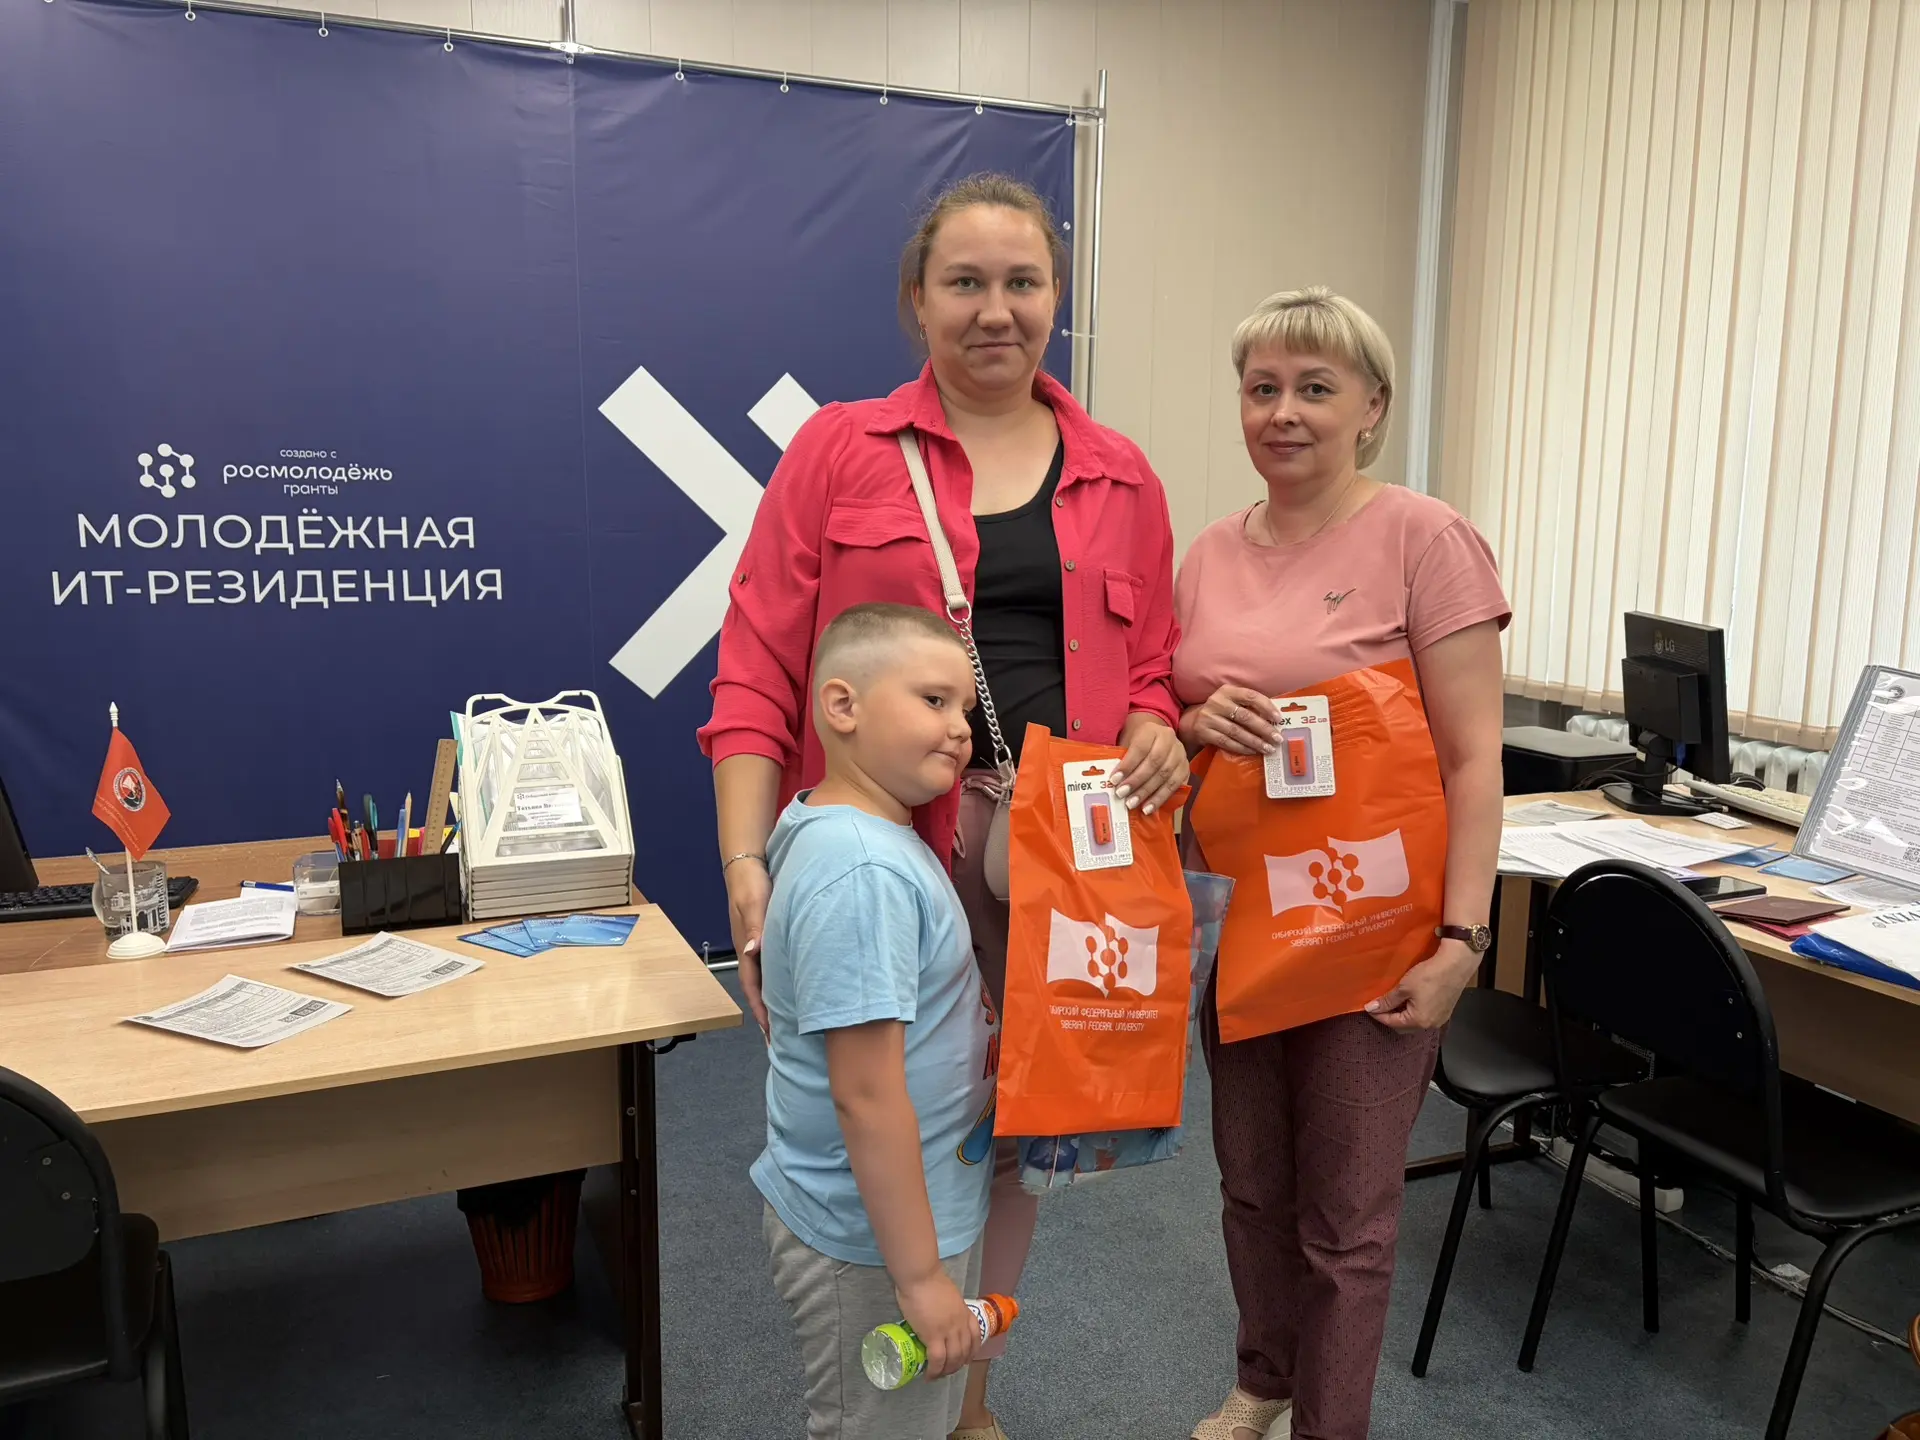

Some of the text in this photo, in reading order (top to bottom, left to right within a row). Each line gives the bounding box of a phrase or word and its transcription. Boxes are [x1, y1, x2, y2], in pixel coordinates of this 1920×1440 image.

[279, 449, 337, 459] создано с
[222, 463, 394, 485] росмолодёжь
[283, 484, 339, 497] гранты
[77, 507, 475, 556] МОЛОДЁЖНАЯ
[51, 568, 503, 610] ИТ-РЕЗИДЕНЦИЯ
[1664, 638, 1675, 653] LG
[1300, 715, 1317, 725] 32
[1067, 780, 1093, 792] mirex
[1290, 918, 1396, 949] SIBERIAN FEDERAL UNIVERSITY
[1080, 1007, 1125, 1019] ФЕДЕРАЛЬНЫЙ
[1060, 1019, 1145, 1031] SIBERIAN FEDERAL UNIVERSITY
